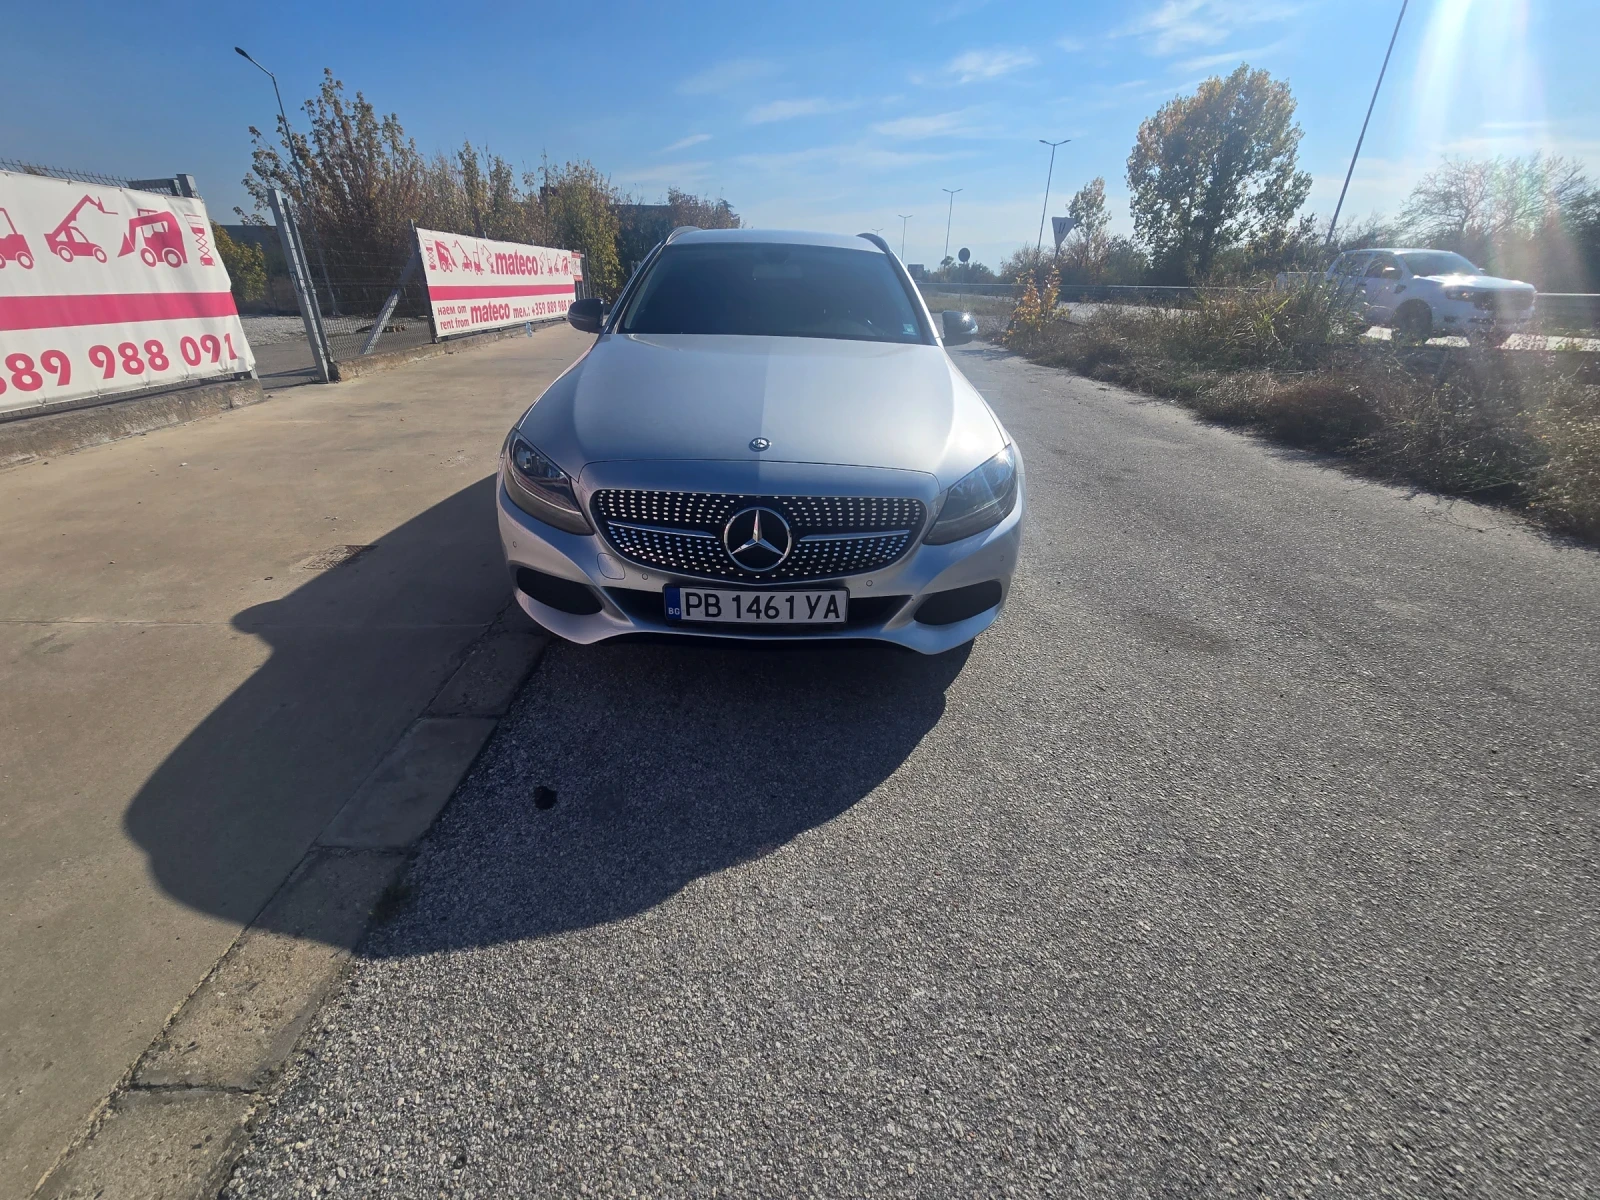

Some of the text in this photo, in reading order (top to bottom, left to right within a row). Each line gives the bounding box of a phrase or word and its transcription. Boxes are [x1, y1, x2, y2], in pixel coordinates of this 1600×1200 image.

[494, 249, 539, 276] mateco
[440, 317, 470, 330] rent from
[470, 301, 510, 324] mateco
[0, 332, 238, 396] 89 988 091
[668, 607, 681, 616] BG
[684, 591, 722, 618] PB
[731, 594, 795, 620] 1461
